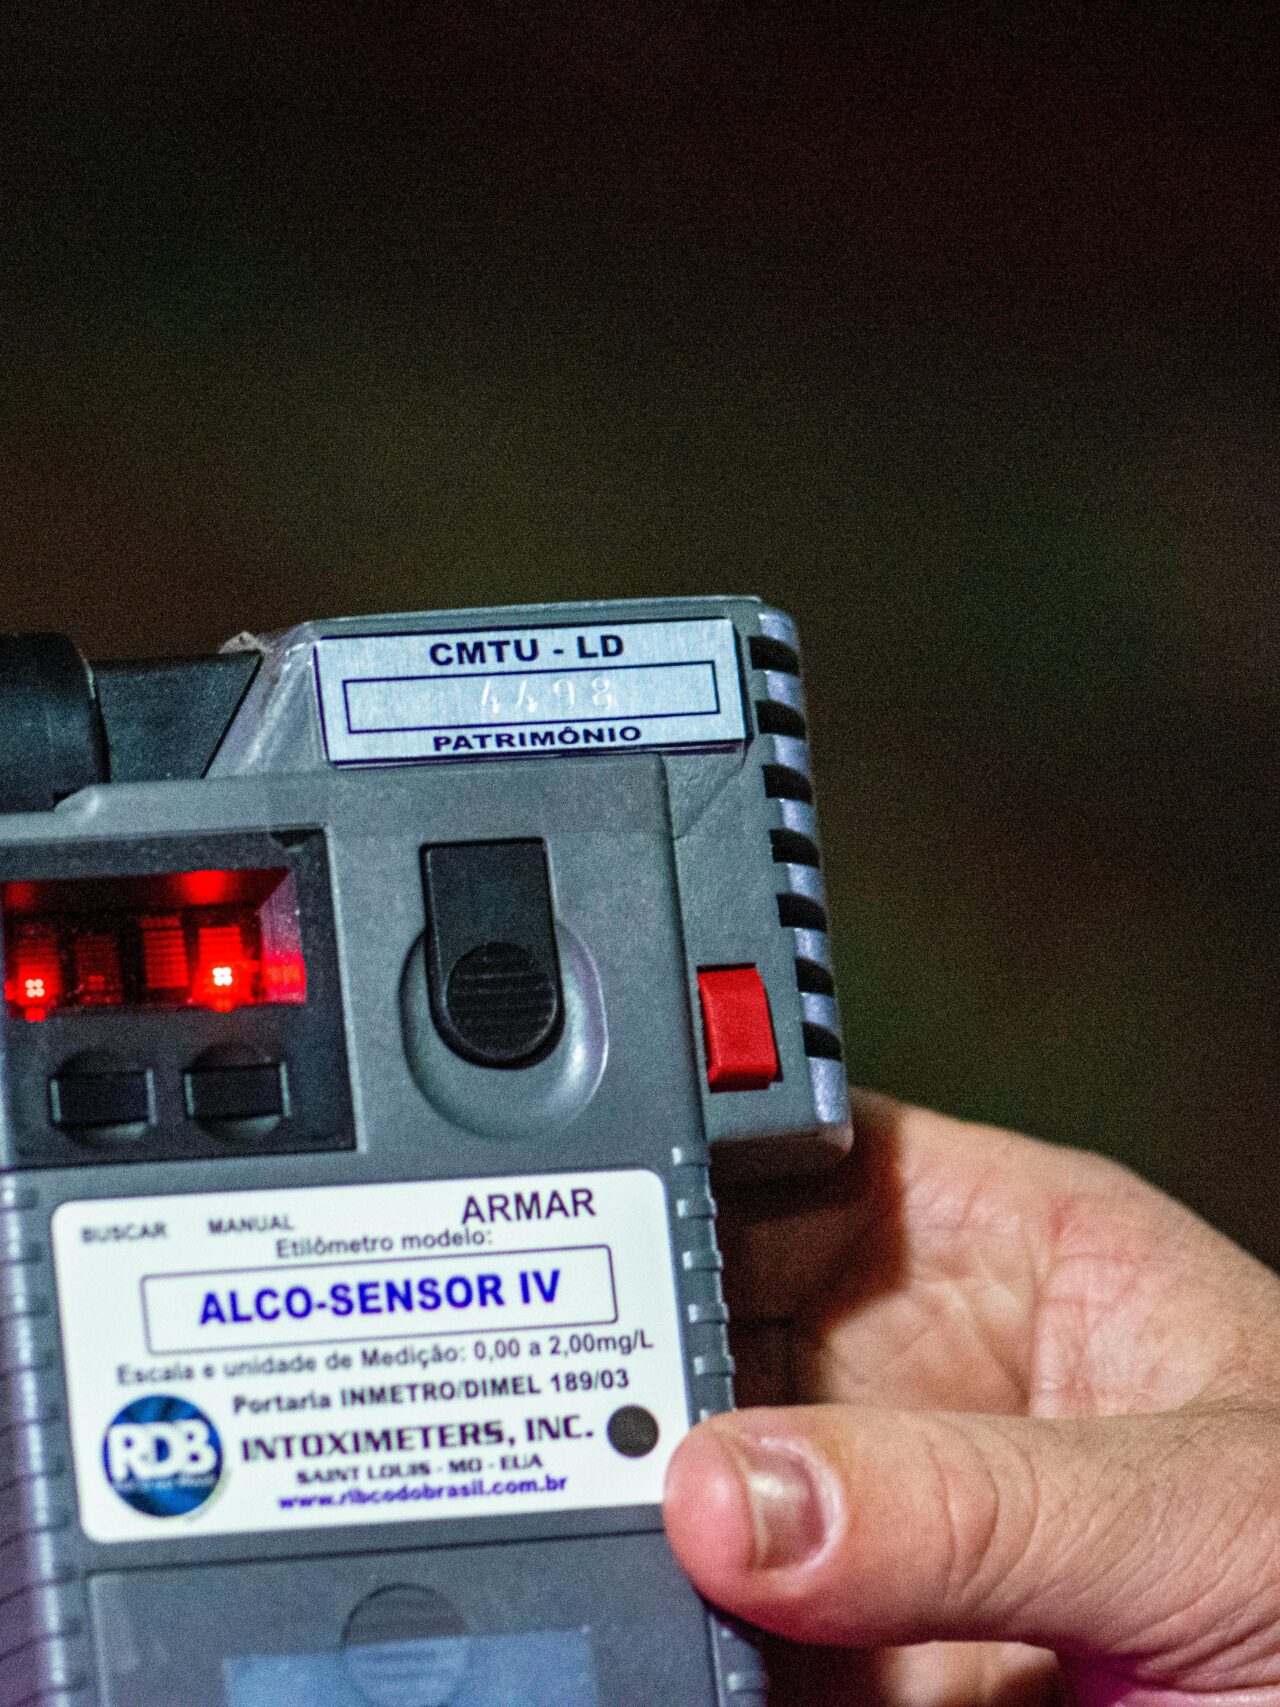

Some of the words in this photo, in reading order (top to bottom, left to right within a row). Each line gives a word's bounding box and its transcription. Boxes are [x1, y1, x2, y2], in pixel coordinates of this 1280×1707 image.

[429, 638, 540, 666] CMTU
[576, 634, 625, 659] LD
[480, 677, 614, 715] 4498
[432, 726, 643, 752] PATRIMÔNIO
[208, 1215, 295, 1235] MANUAL
[461, 1188, 597, 1225] ARMAR
[81, 1221, 168, 1244] BUSCAR
[275, 1235, 394, 1259] Etilômetro
[401, 1227, 494, 1250] modelo:
[198, 1273, 506, 1326] ALCO-SENSOR
[518, 1269, 561, 1304] IV
[116, 1363, 195, 1386] Escala
[202, 1364, 215, 1380] e
[223, 1354, 318, 1377] unidade
[325, 1351, 353, 1370] de
[361, 1345, 466, 1369] Medição:
[473, 1338, 522, 1362] 0,00
[528, 1341, 542, 1357] a
[548, 1329, 654, 1358] 2,00mg/L
[233, 1390, 332, 1415] Portaria
[340, 1377, 542, 1408] INMETRO/DIMEL
[549, 1368, 630, 1393] 189/03
[109, 1419, 218, 1481] RDB
[240, 1419, 516, 1462] INTOXIMETERS,
[525, 1414, 595, 1443] INC.
[296, 1465, 359, 1485] SAINT
[367, 1462, 432, 1481] LOUIS
[448, 1458, 483, 1474] MO
[500, 1453, 544, 1472] EUA
